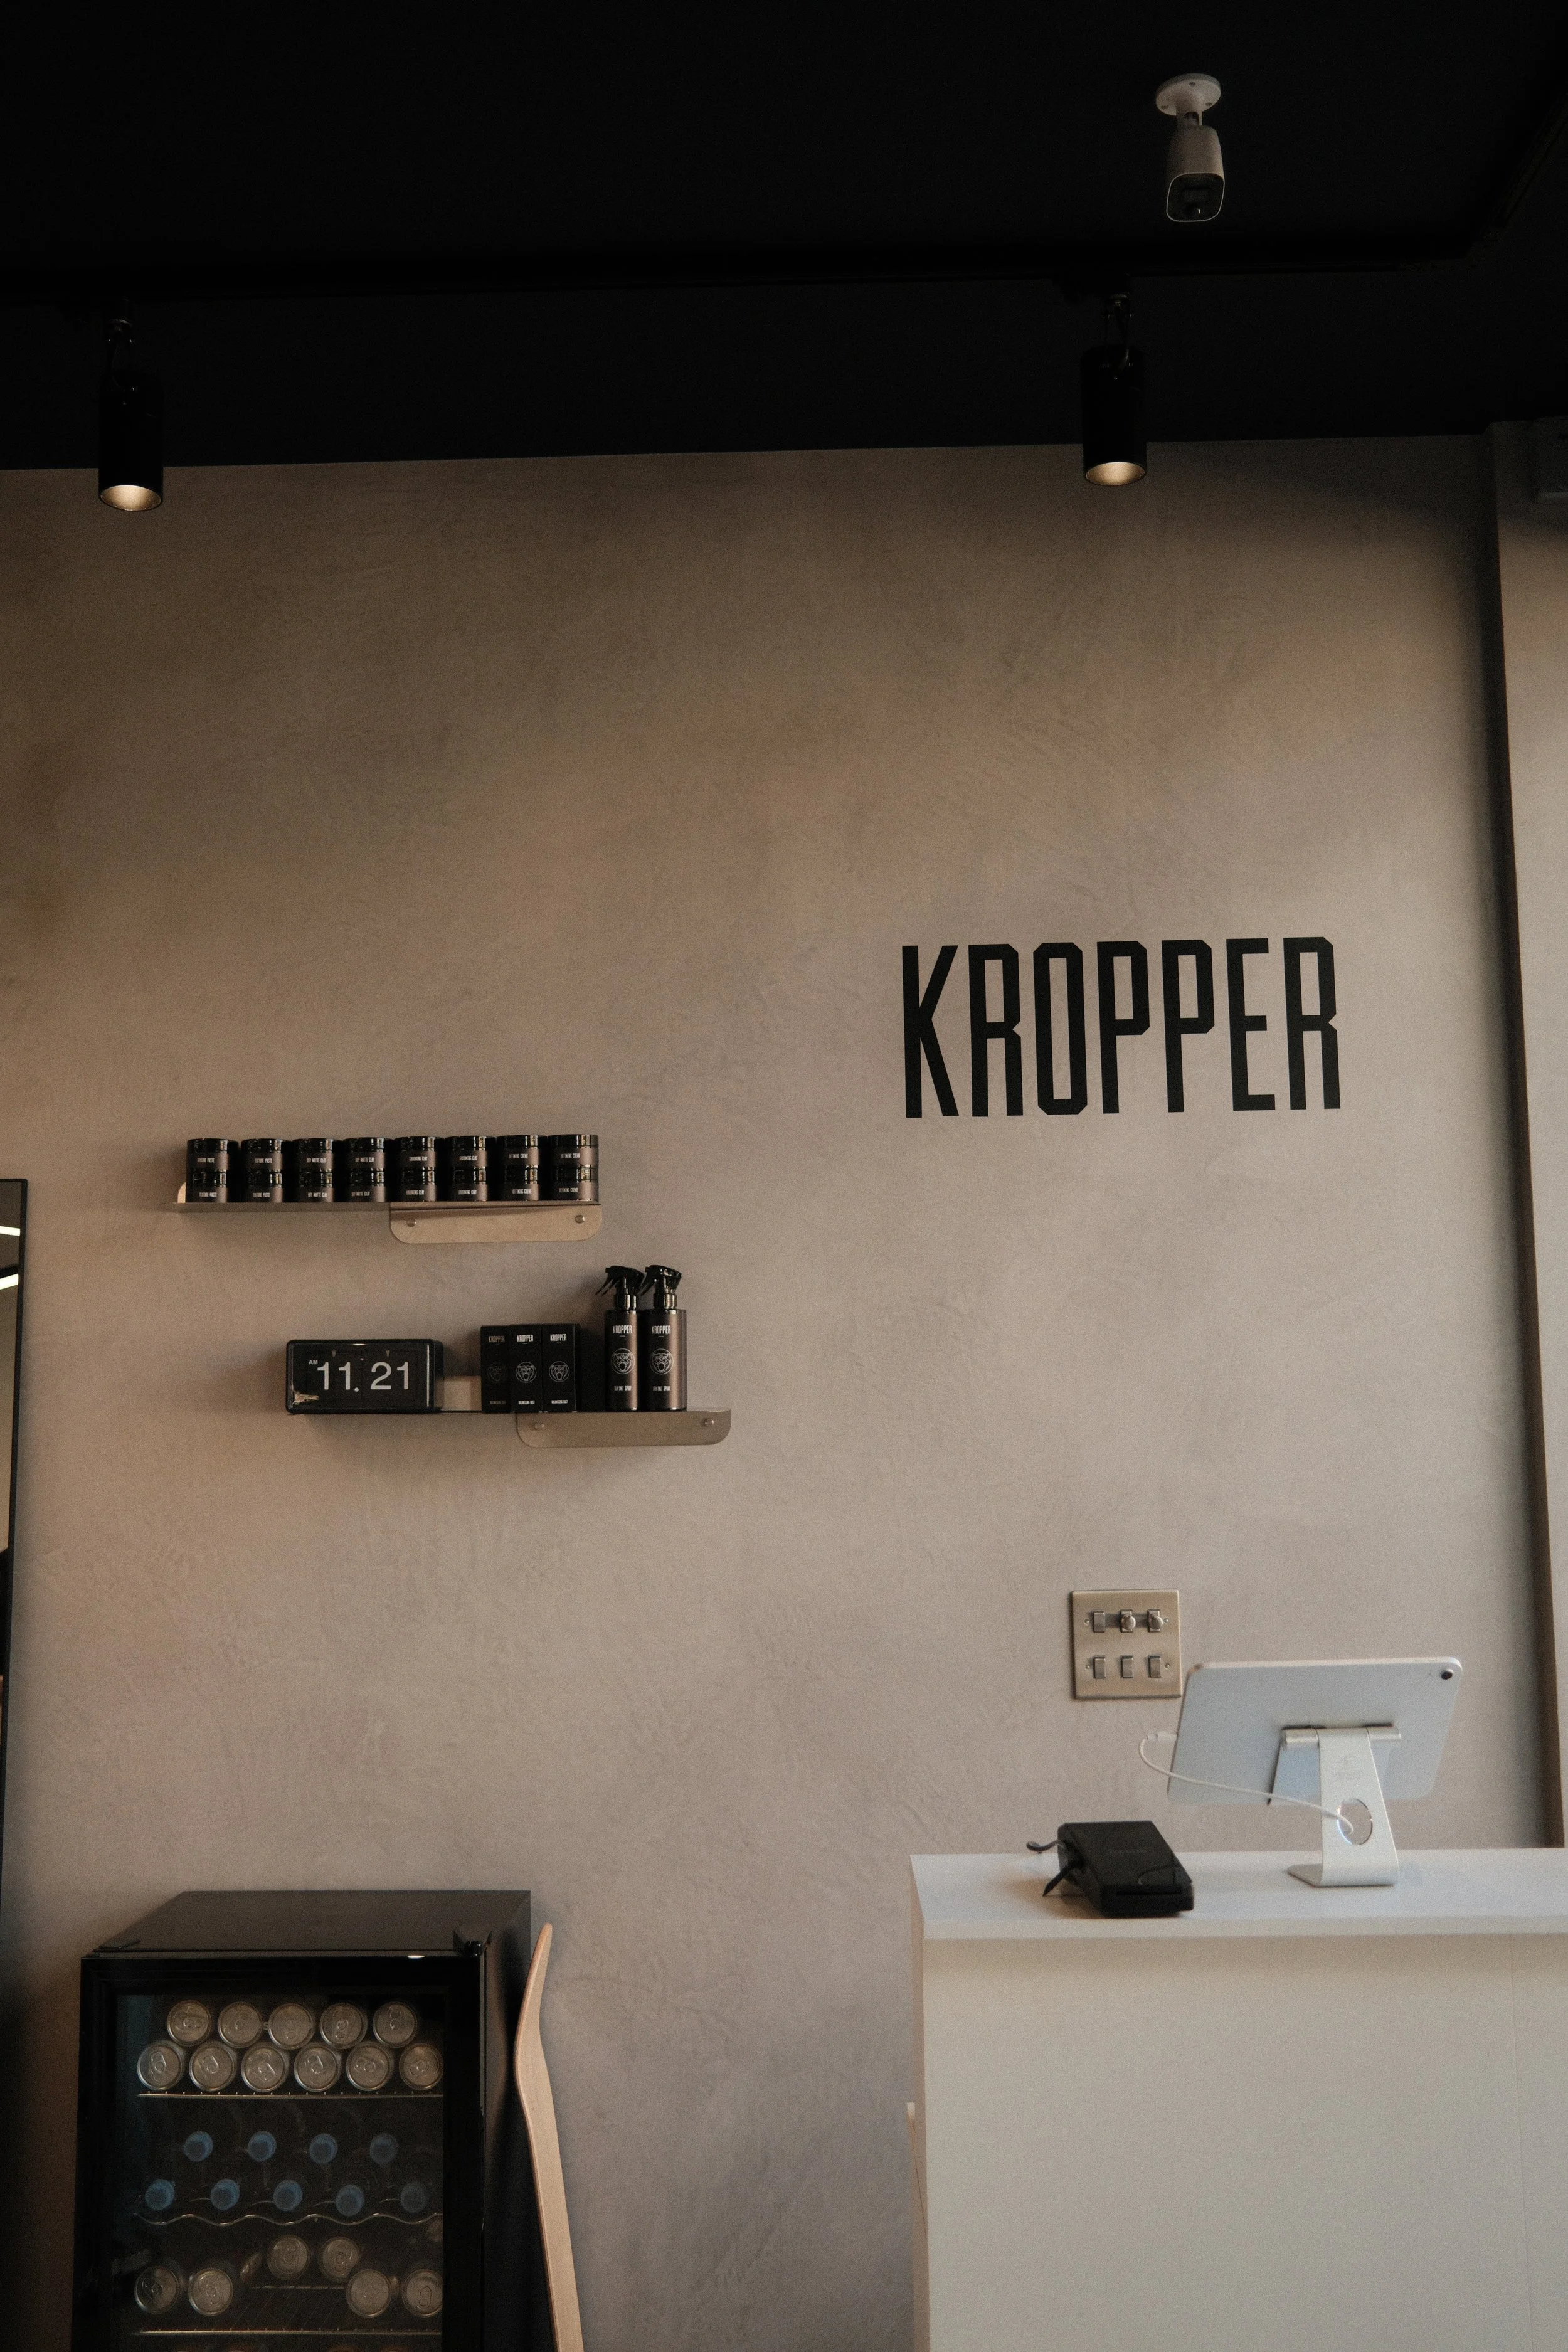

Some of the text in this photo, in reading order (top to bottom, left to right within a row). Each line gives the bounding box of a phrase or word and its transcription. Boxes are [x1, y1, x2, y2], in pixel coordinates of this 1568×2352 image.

[902, 936, 1341, 1119] KROPPER
[613, 1325, 632, 1334] KROPPER
[652, 1325, 671, 1334] KROPPER
[516, 1334, 533, 1342] KROPPER
[550, 1333, 567, 1342] KROPPER
